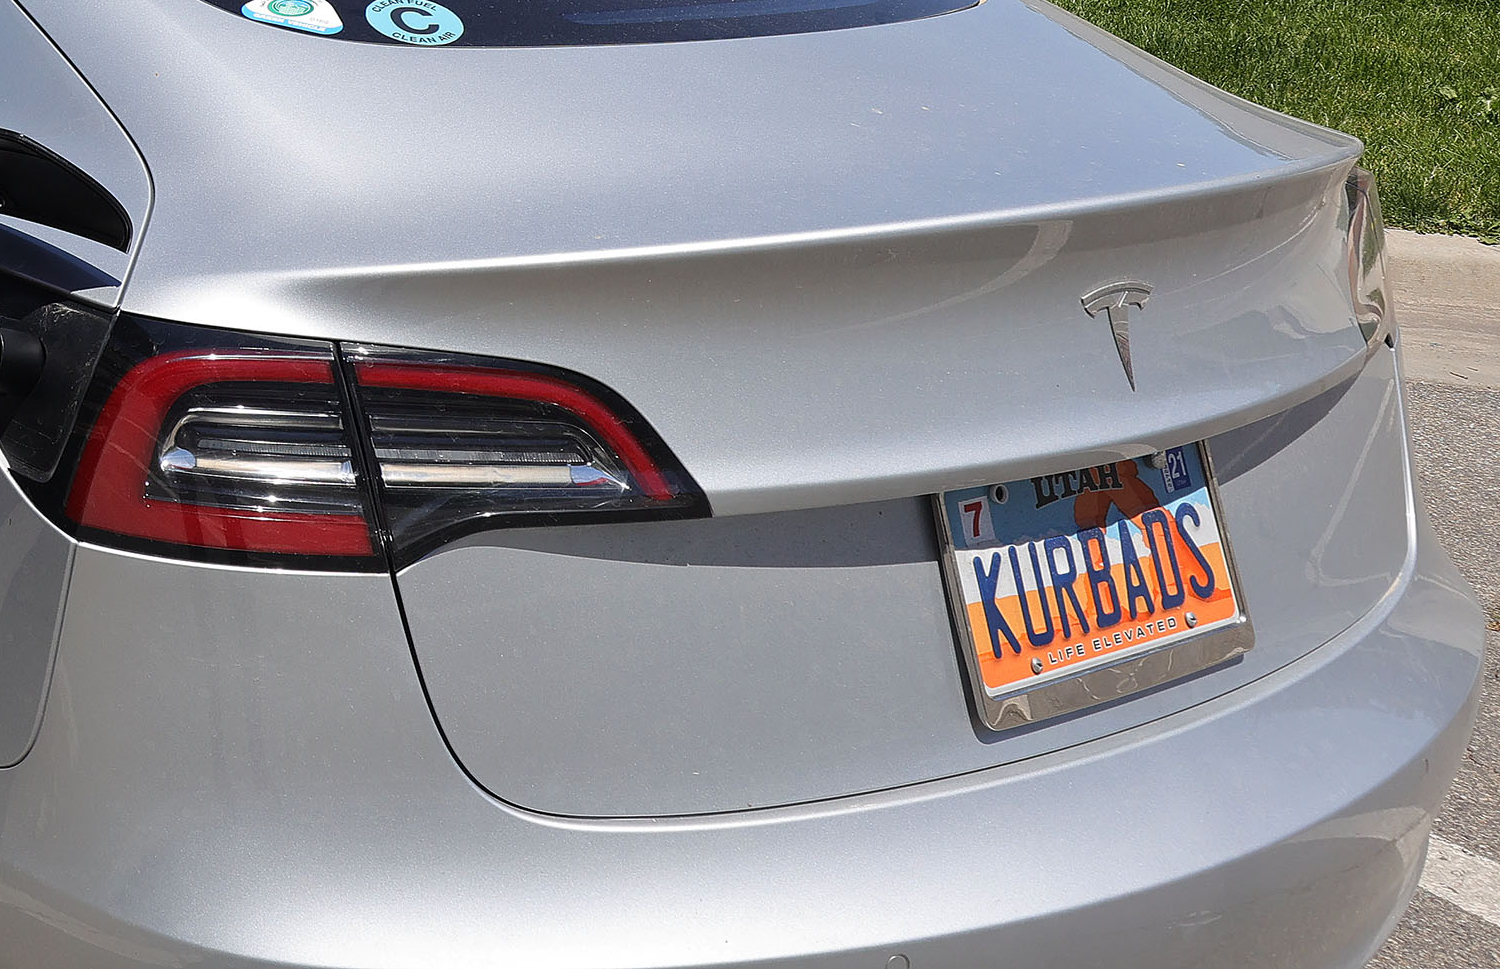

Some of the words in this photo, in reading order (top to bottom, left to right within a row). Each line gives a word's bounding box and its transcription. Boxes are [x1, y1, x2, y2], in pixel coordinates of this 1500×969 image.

[372, 0, 404, 12] CLEAN
[407, 0, 437, 11] FUEL
[390, 7, 439, 35] C
[392, 32, 437, 43] CLEAN
[438, 31, 456, 42] AIR
[1168, 451, 1187, 479] 21
[1031, 463, 1123, 509] UTAH
[963, 501, 983, 538] 7
[973, 502, 1215, 659] KURBADS
[1048, 642, 1085, 665] LIFE
[1093, 617, 1177, 651] ELEVATED
